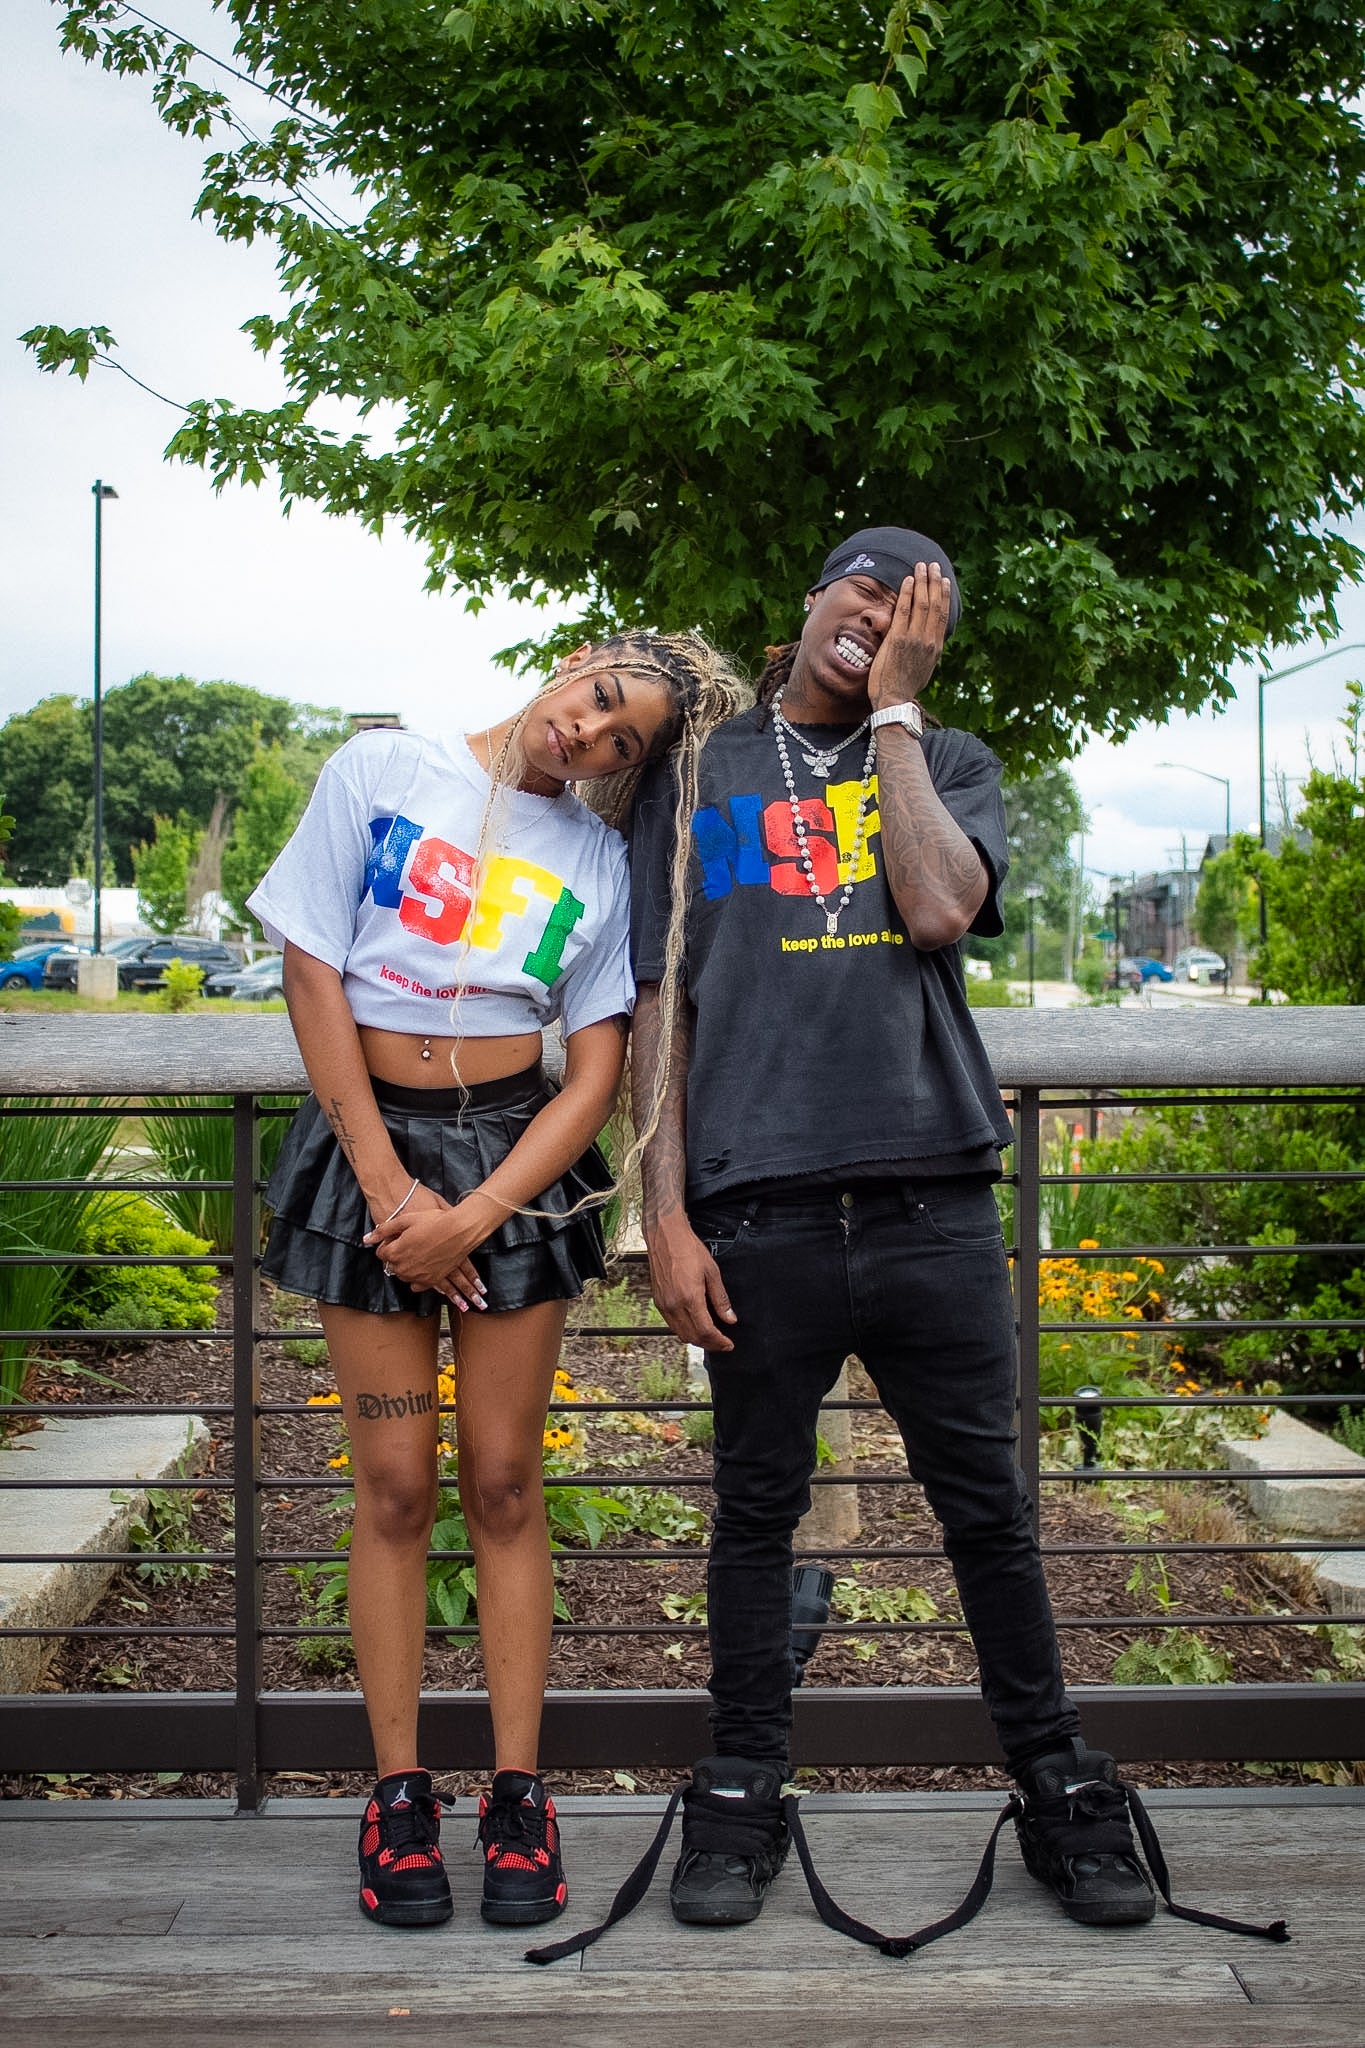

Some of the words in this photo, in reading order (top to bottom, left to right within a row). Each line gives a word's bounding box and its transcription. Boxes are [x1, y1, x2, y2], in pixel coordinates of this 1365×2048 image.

[781, 937, 818, 953] keep
[820, 934, 845, 949] the
[848, 932, 878, 947] love
[379, 965, 409, 989] keep
[411, 980, 432, 997] the
[356, 1389, 433, 1419] Divine
